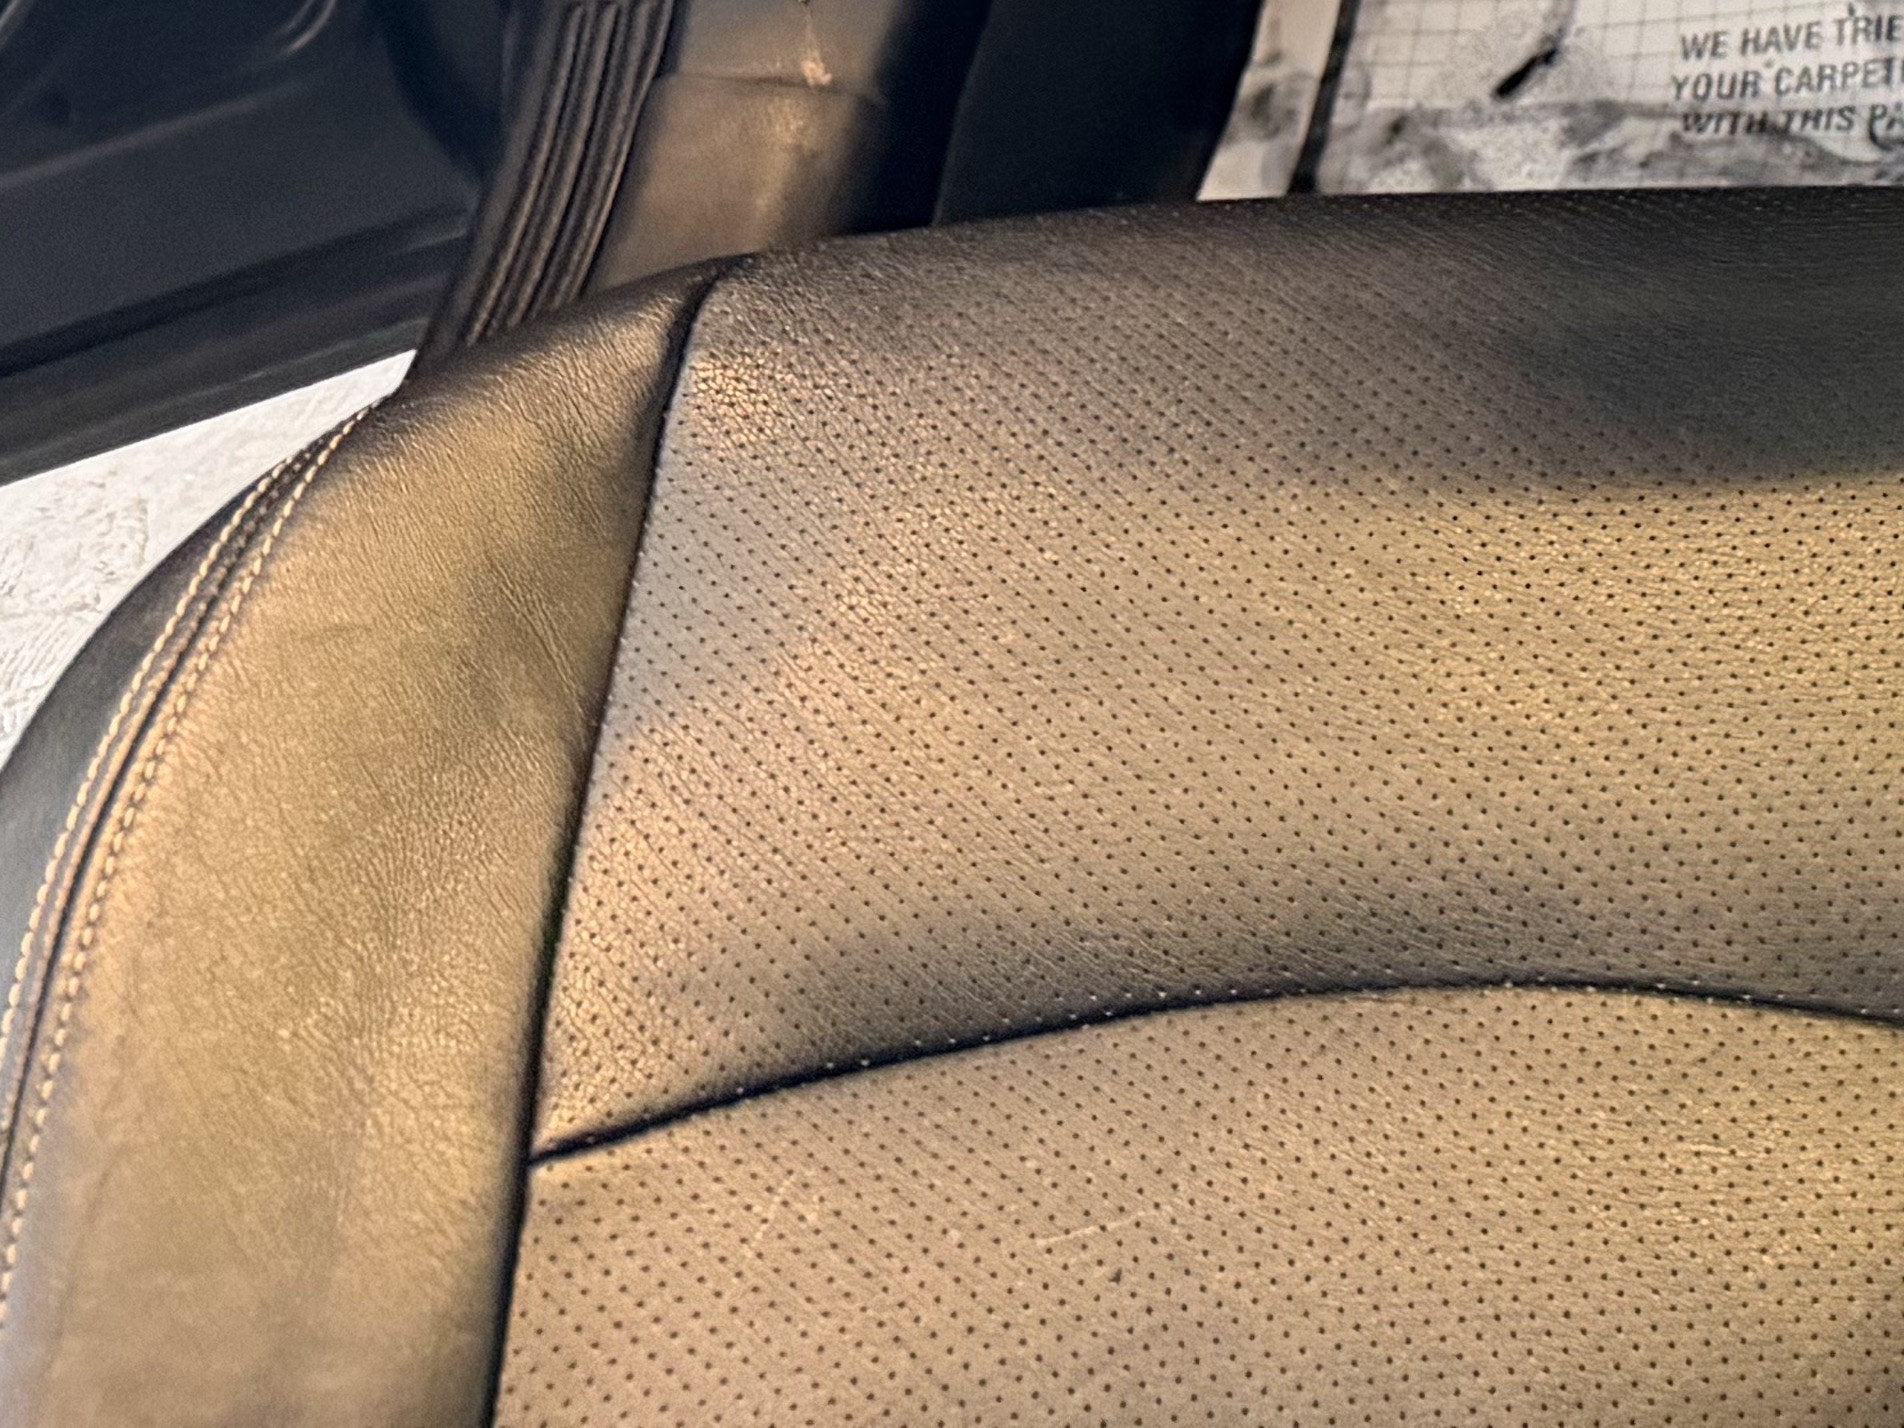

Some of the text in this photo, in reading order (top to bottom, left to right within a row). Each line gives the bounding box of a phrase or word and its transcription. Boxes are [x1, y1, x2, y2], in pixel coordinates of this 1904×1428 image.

[1680, 30, 1729, 61] WE
[1740, 20, 1825, 56] HAVE
[1670, 70, 1761, 102] YOUR
[1681, 109, 1769, 137] WITH
[1782, 105, 1856, 135] THIS
